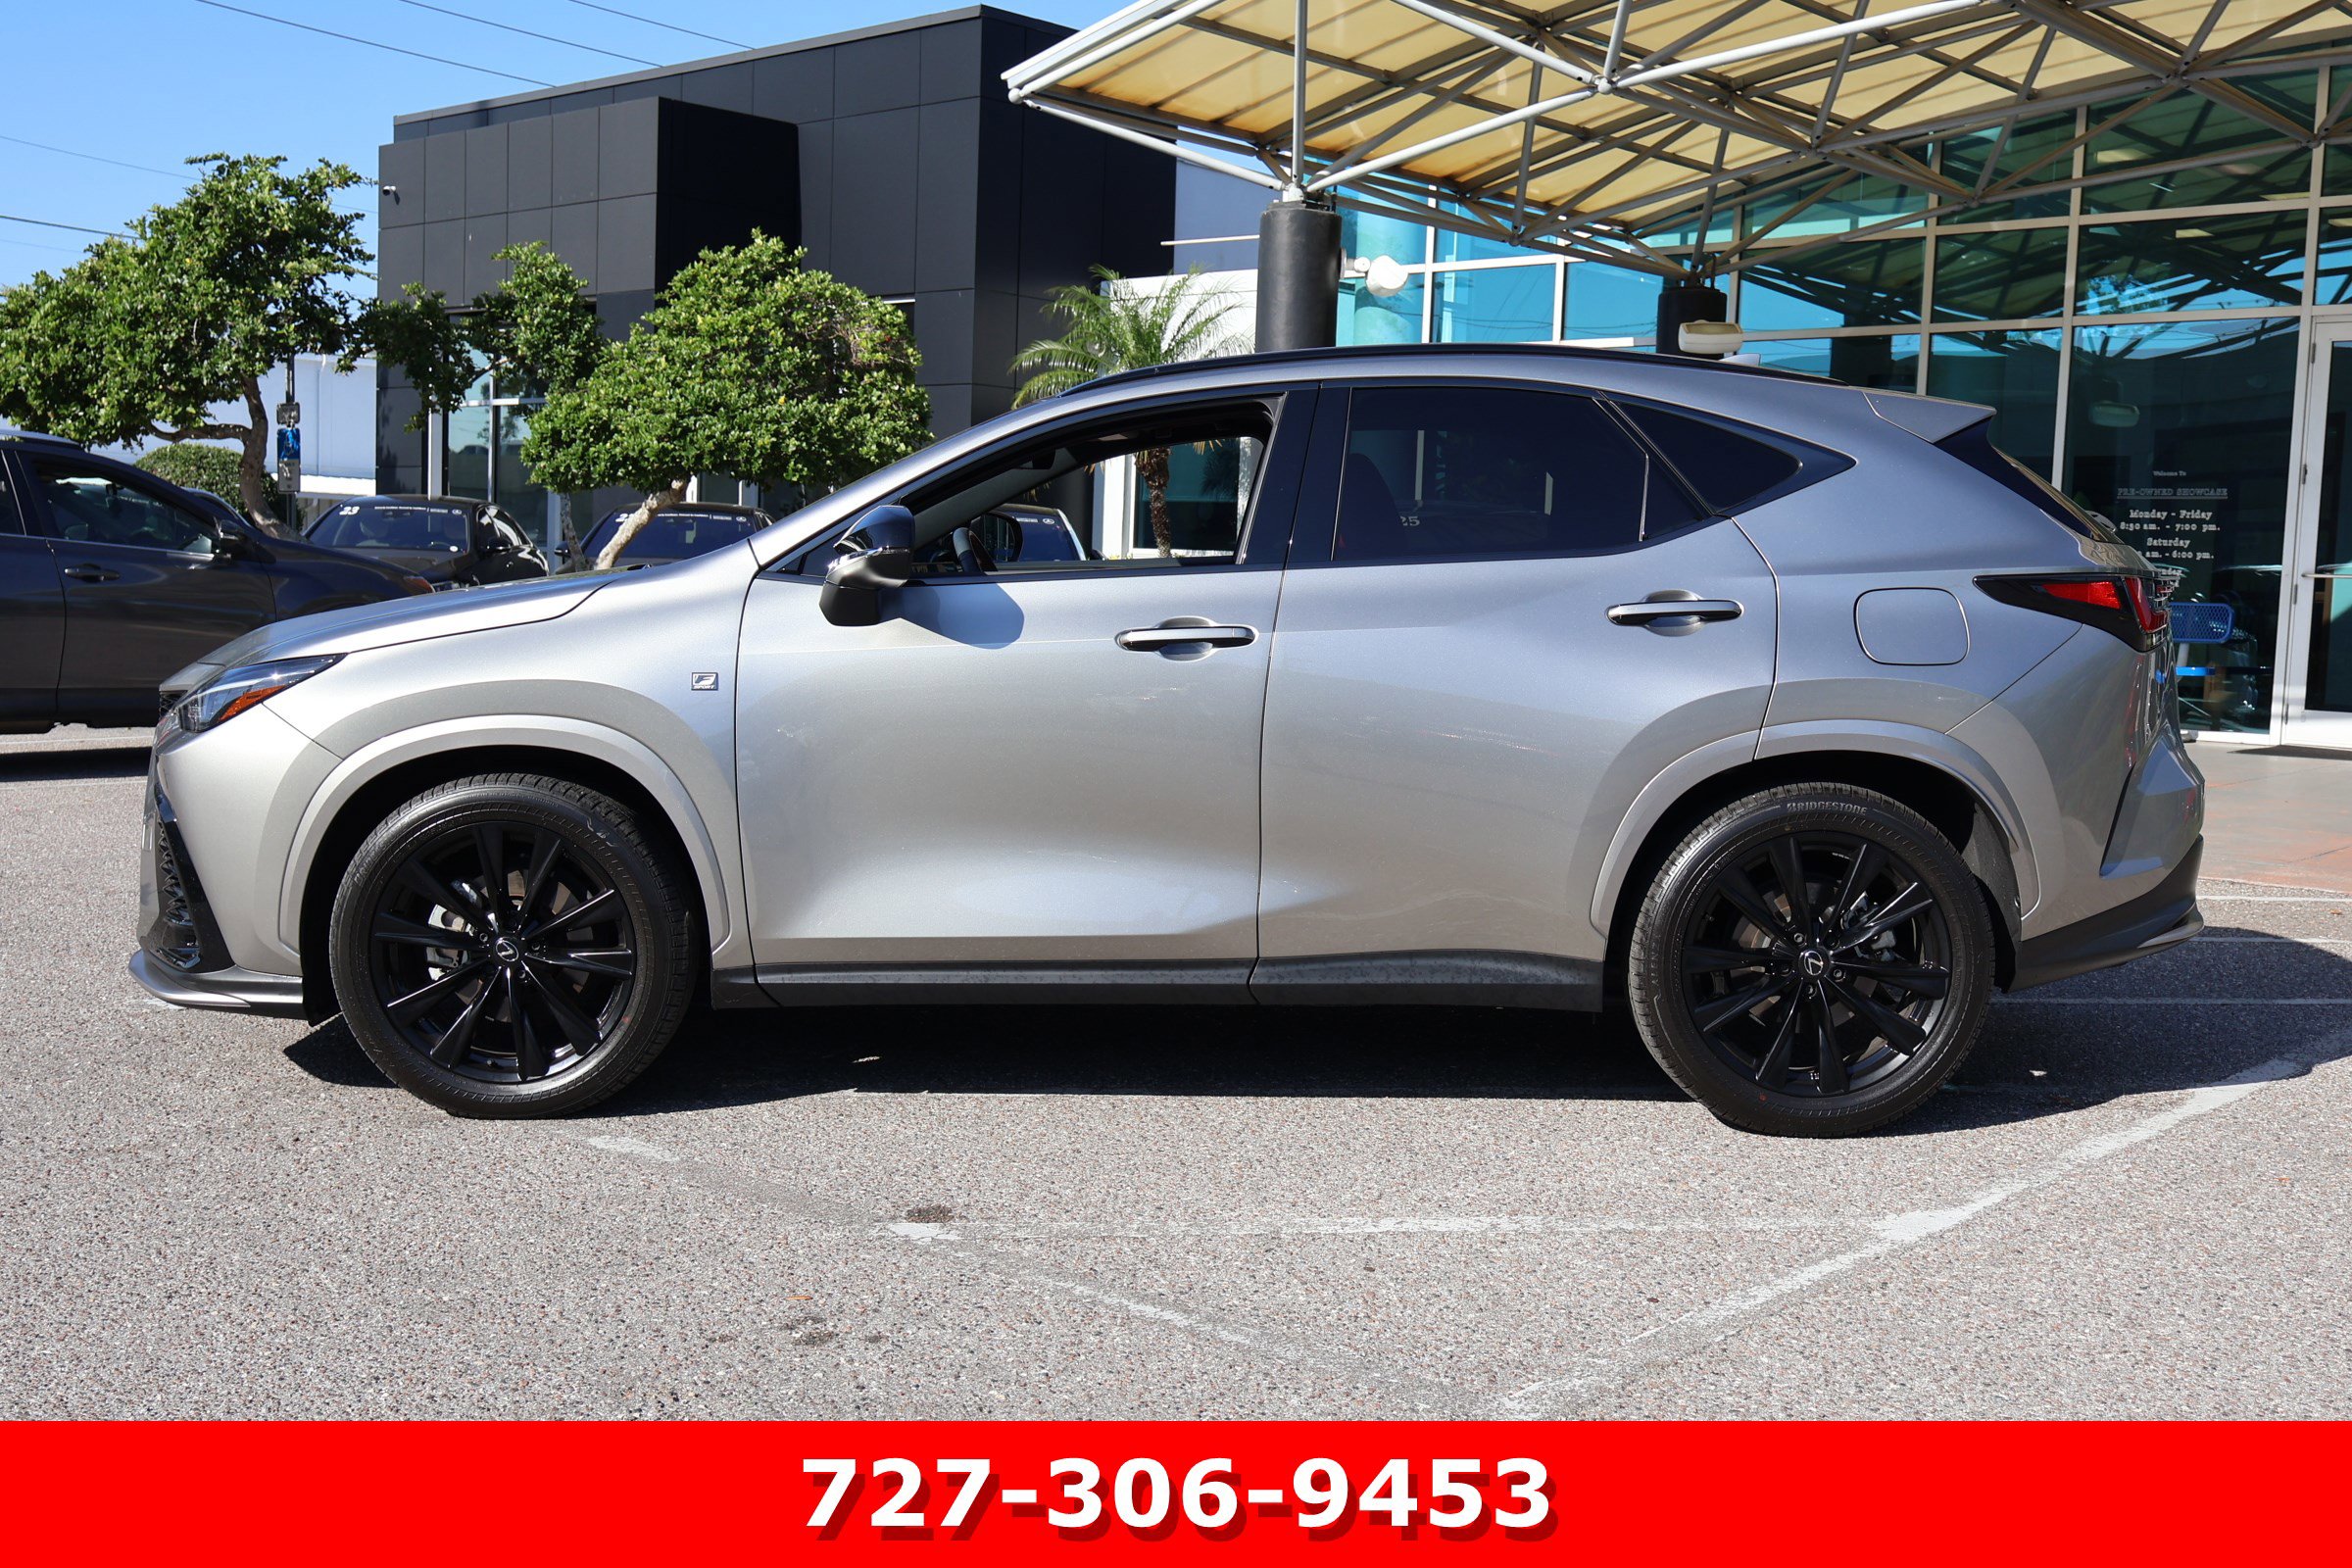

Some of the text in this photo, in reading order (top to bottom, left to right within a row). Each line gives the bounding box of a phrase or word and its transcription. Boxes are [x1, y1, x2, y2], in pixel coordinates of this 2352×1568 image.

[339, 506, 361, 515] 23
[2129, 510, 2168, 519] Monday
[2179, 510, 2212, 520] Friday
[2146, 538, 2190, 547] Saturday
[1787, 801, 1868, 815] BRIDGESTONE
